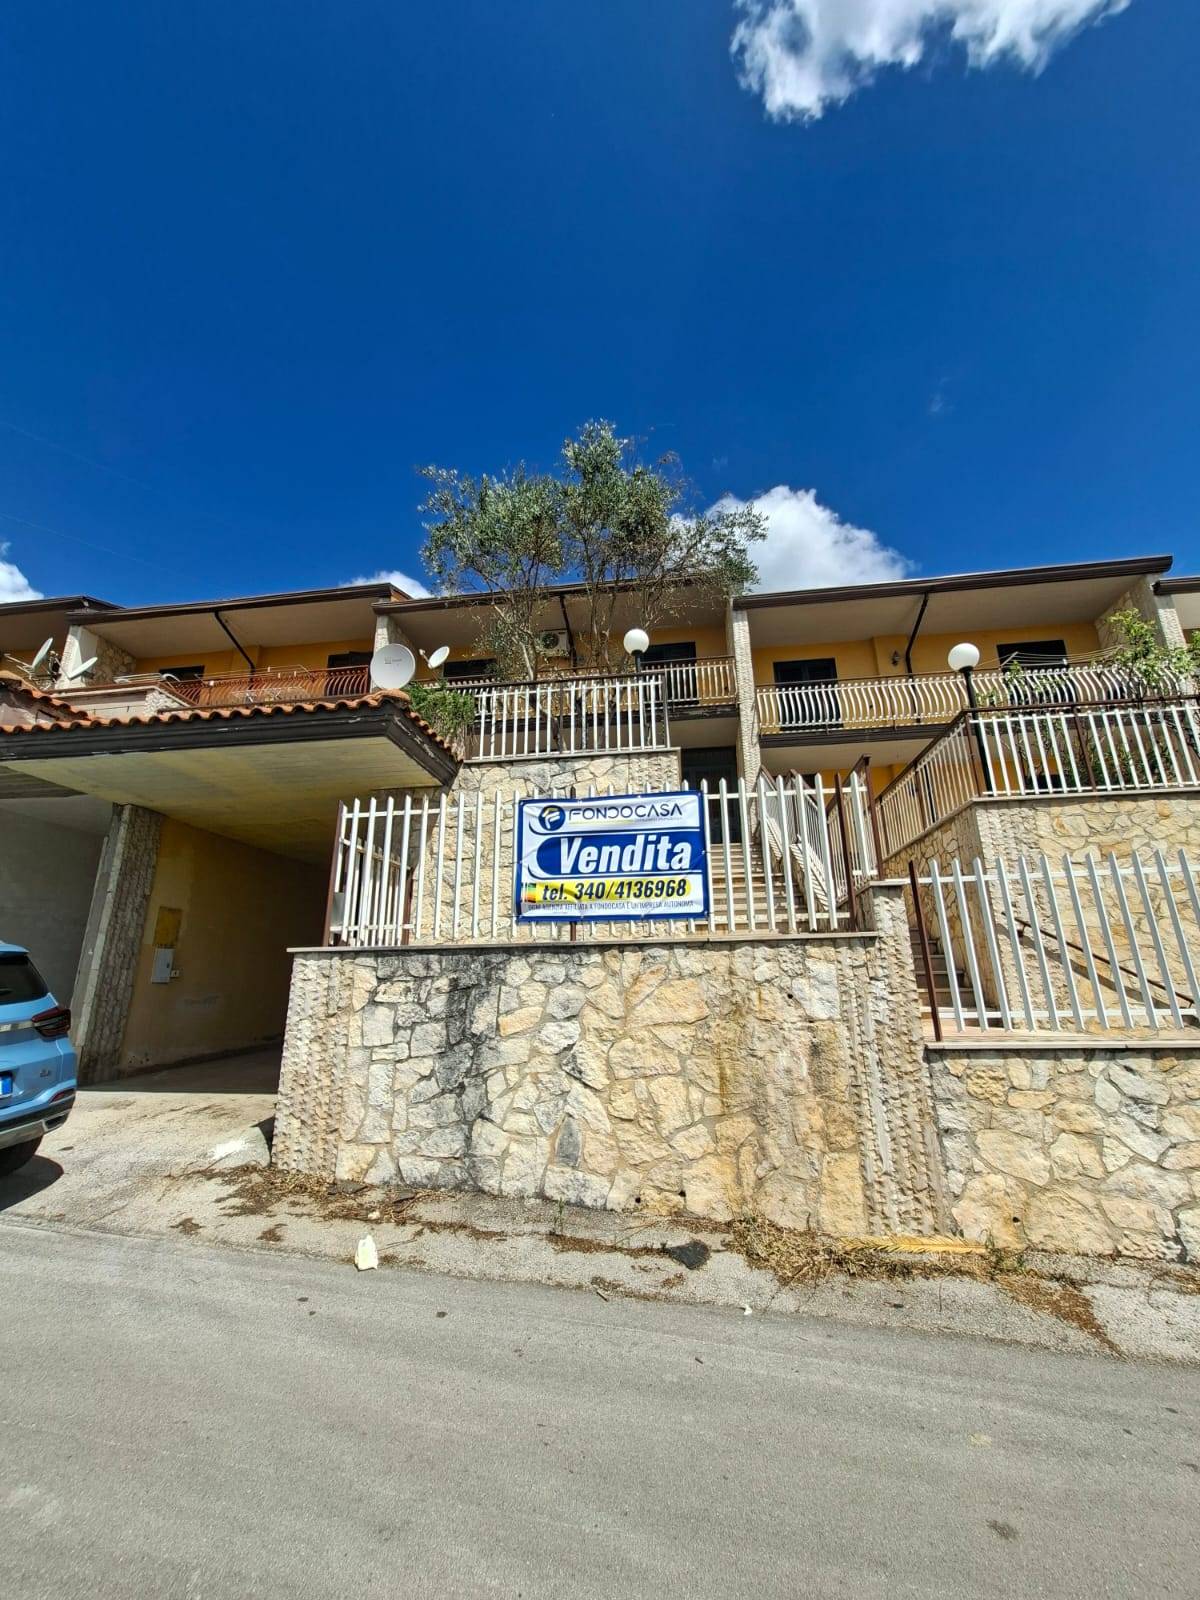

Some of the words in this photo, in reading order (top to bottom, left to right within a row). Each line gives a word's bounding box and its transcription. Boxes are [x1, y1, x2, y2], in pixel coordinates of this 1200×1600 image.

[568, 803, 683, 820] FONDOCASA
[560, 834, 693, 875] Vendita
[542, 884, 568, 901] tel.
[574, 879, 687, 900] 340/4136968
